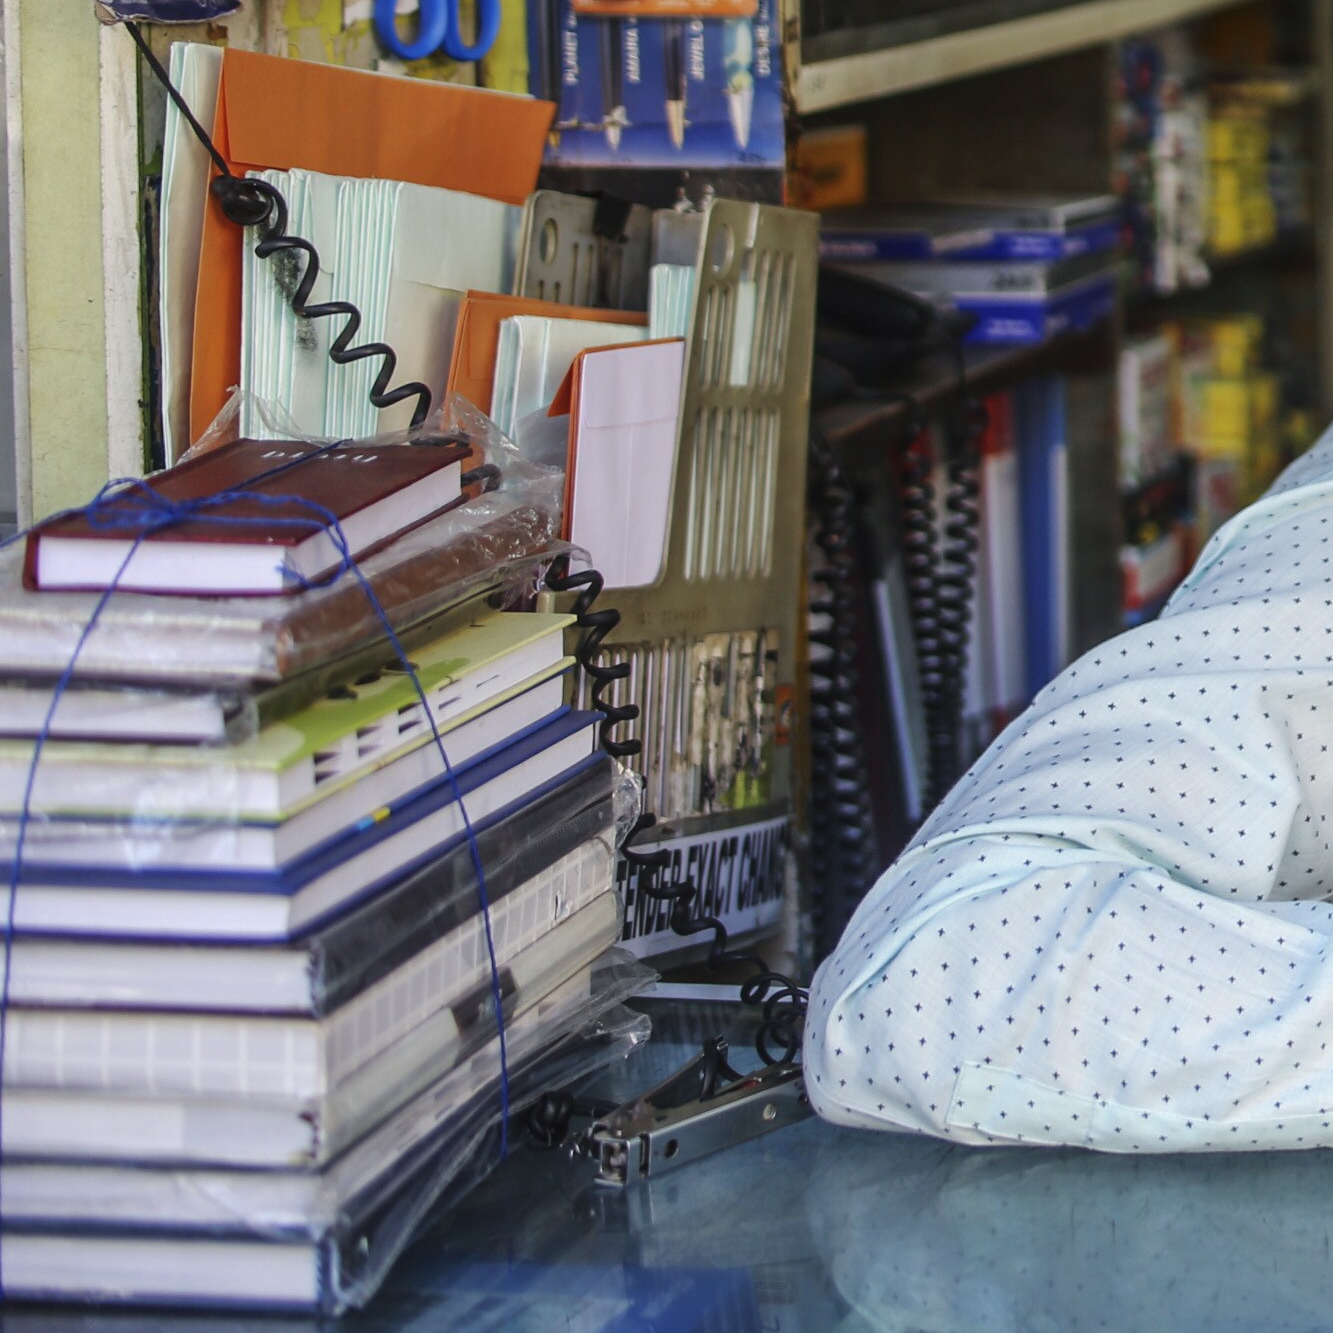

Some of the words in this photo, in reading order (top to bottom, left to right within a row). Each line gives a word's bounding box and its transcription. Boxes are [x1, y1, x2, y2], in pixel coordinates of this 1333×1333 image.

[563, 29, 579, 86] PLANET
[689, 35, 706, 82] JEWEL
[755, 23, 772, 77] DESIRE
[687, 836, 739, 922] EXACT
